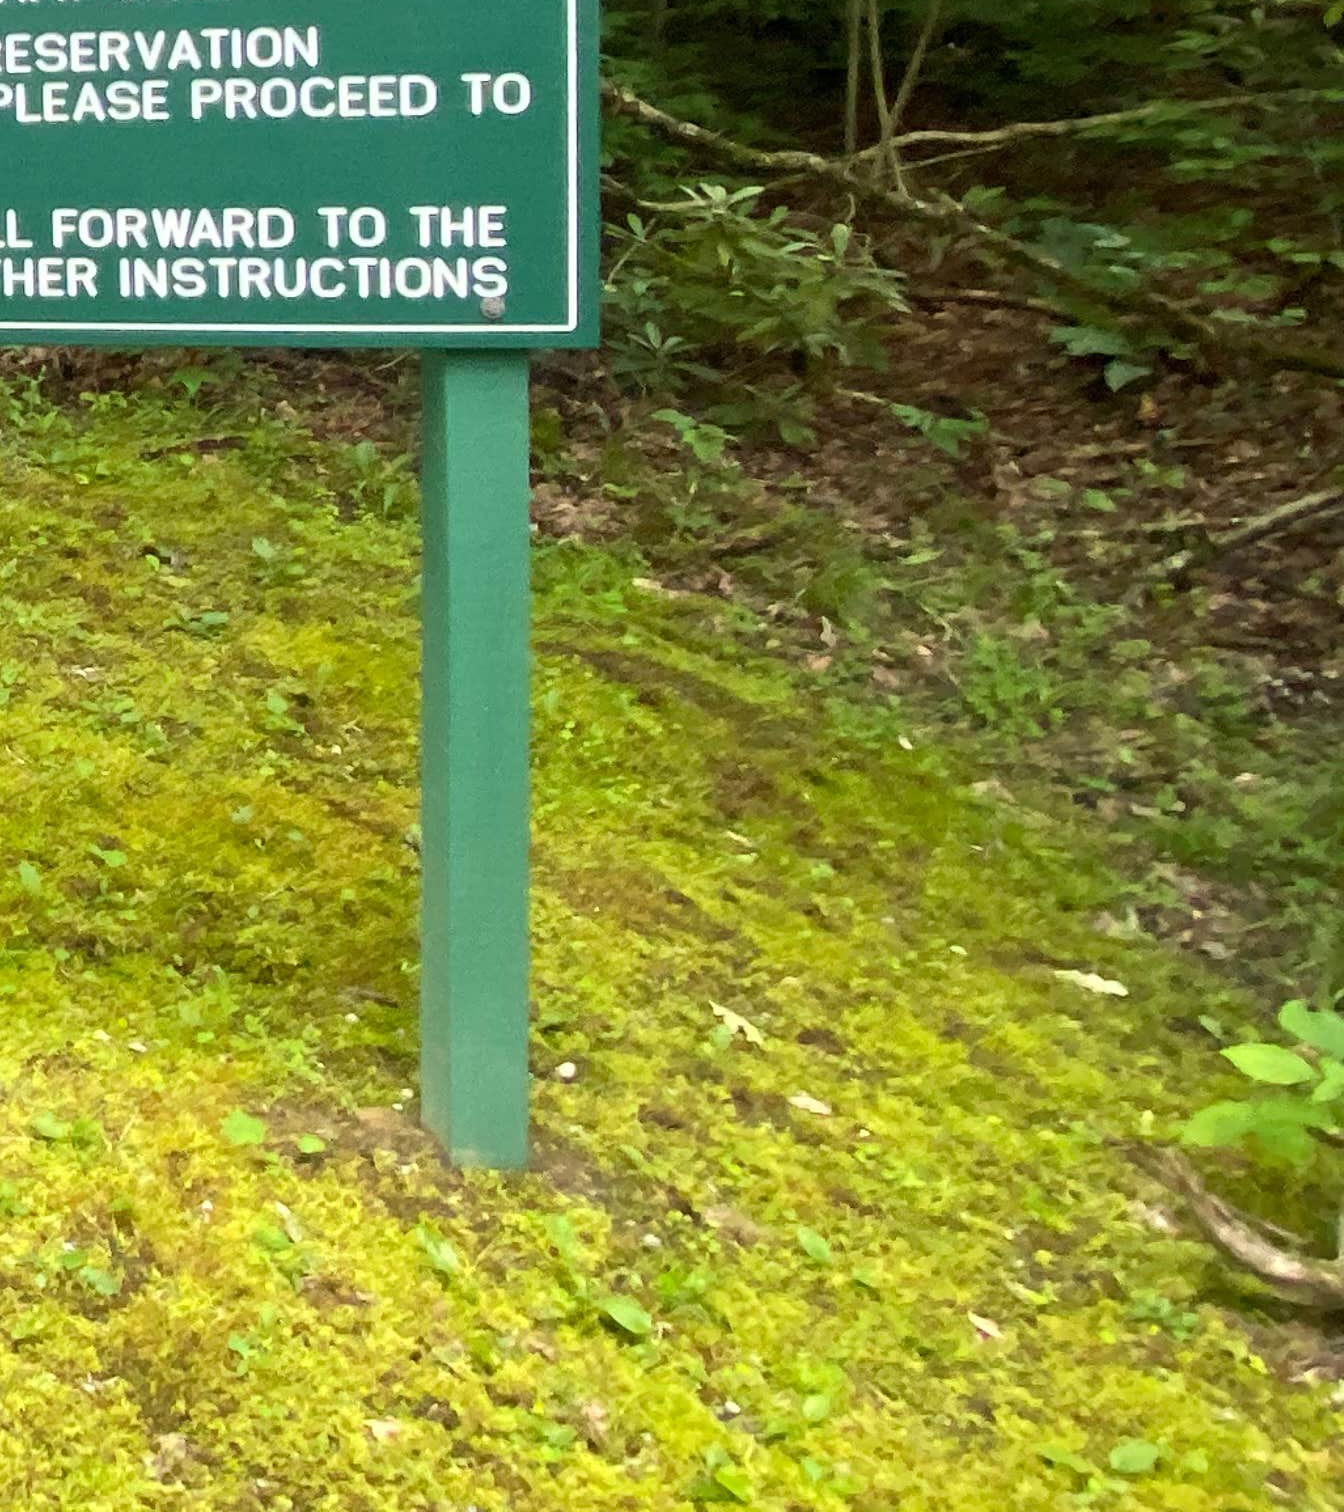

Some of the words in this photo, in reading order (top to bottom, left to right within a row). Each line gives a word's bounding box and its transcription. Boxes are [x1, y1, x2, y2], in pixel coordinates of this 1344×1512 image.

[191, 74, 438, 120] PROCEED
[461, 72, 531, 116] TO
[52, 207, 295, 249] FORWARD
[317, 206, 386, 249] TO
[409, 205, 507, 248] THE
[119, 256, 508, 299] INSTRUCTIONS
